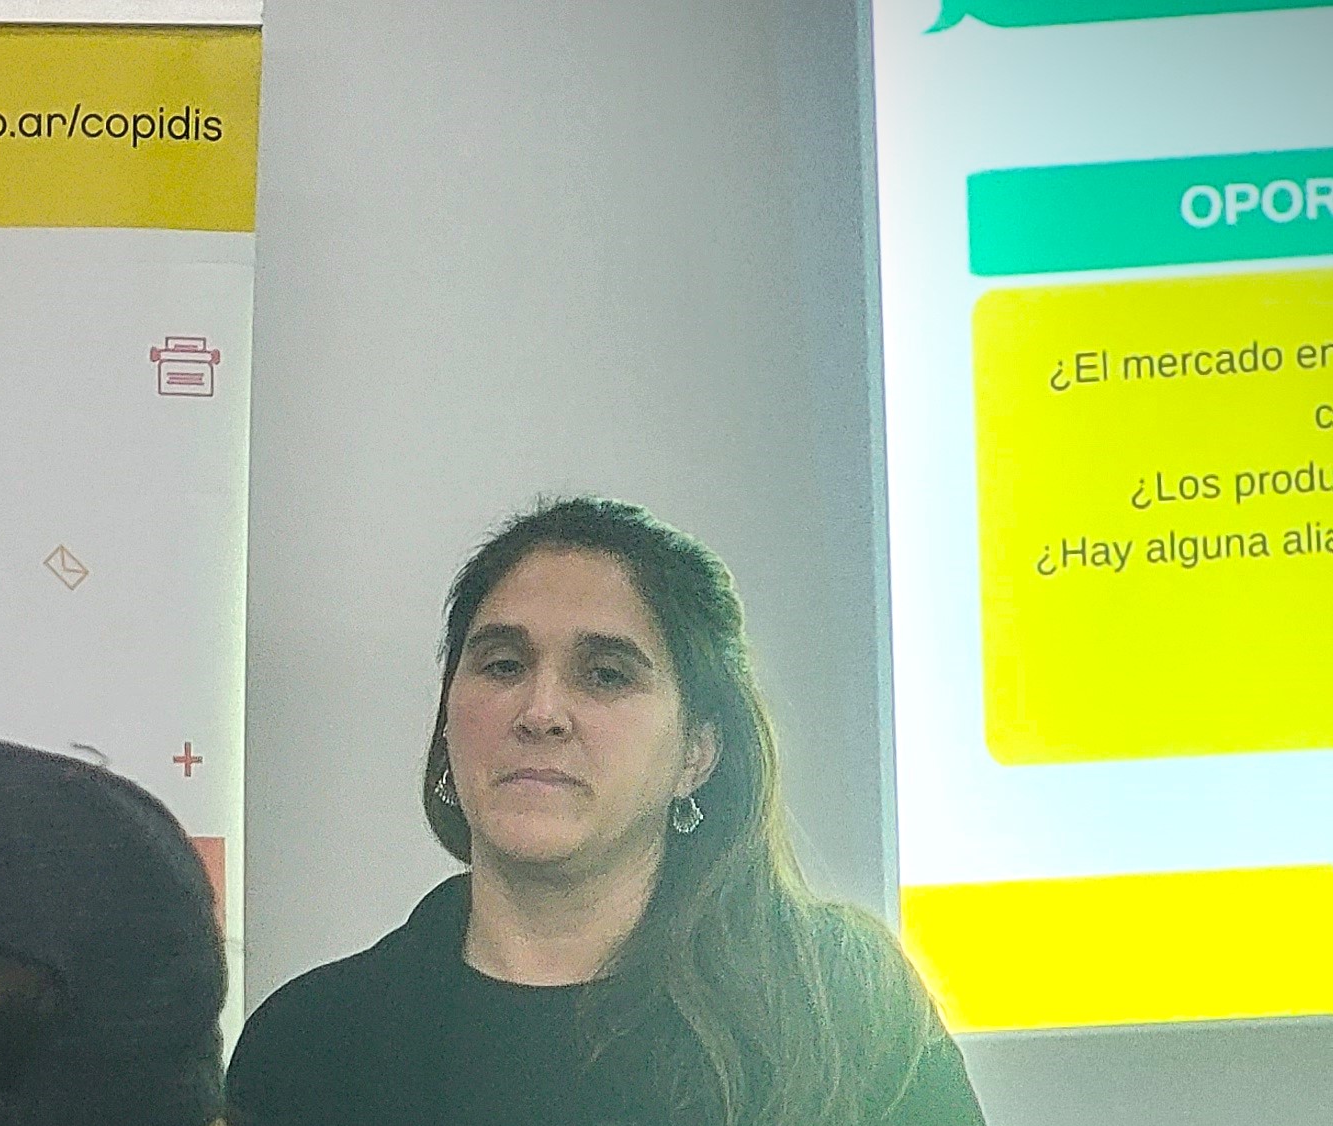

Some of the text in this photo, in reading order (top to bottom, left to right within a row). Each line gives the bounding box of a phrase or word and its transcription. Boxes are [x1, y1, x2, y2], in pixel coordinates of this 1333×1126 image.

[1180, 177, 1333, 229] OPOR
[1049, 350, 1109, 392] ¿El
[1123, 340, 1283, 381] mercado
[1131, 471, 1221, 509] ¿Los
[1036, 536, 1132, 576] ¿Hay
[1146, 530, 1270, 569] alguna
